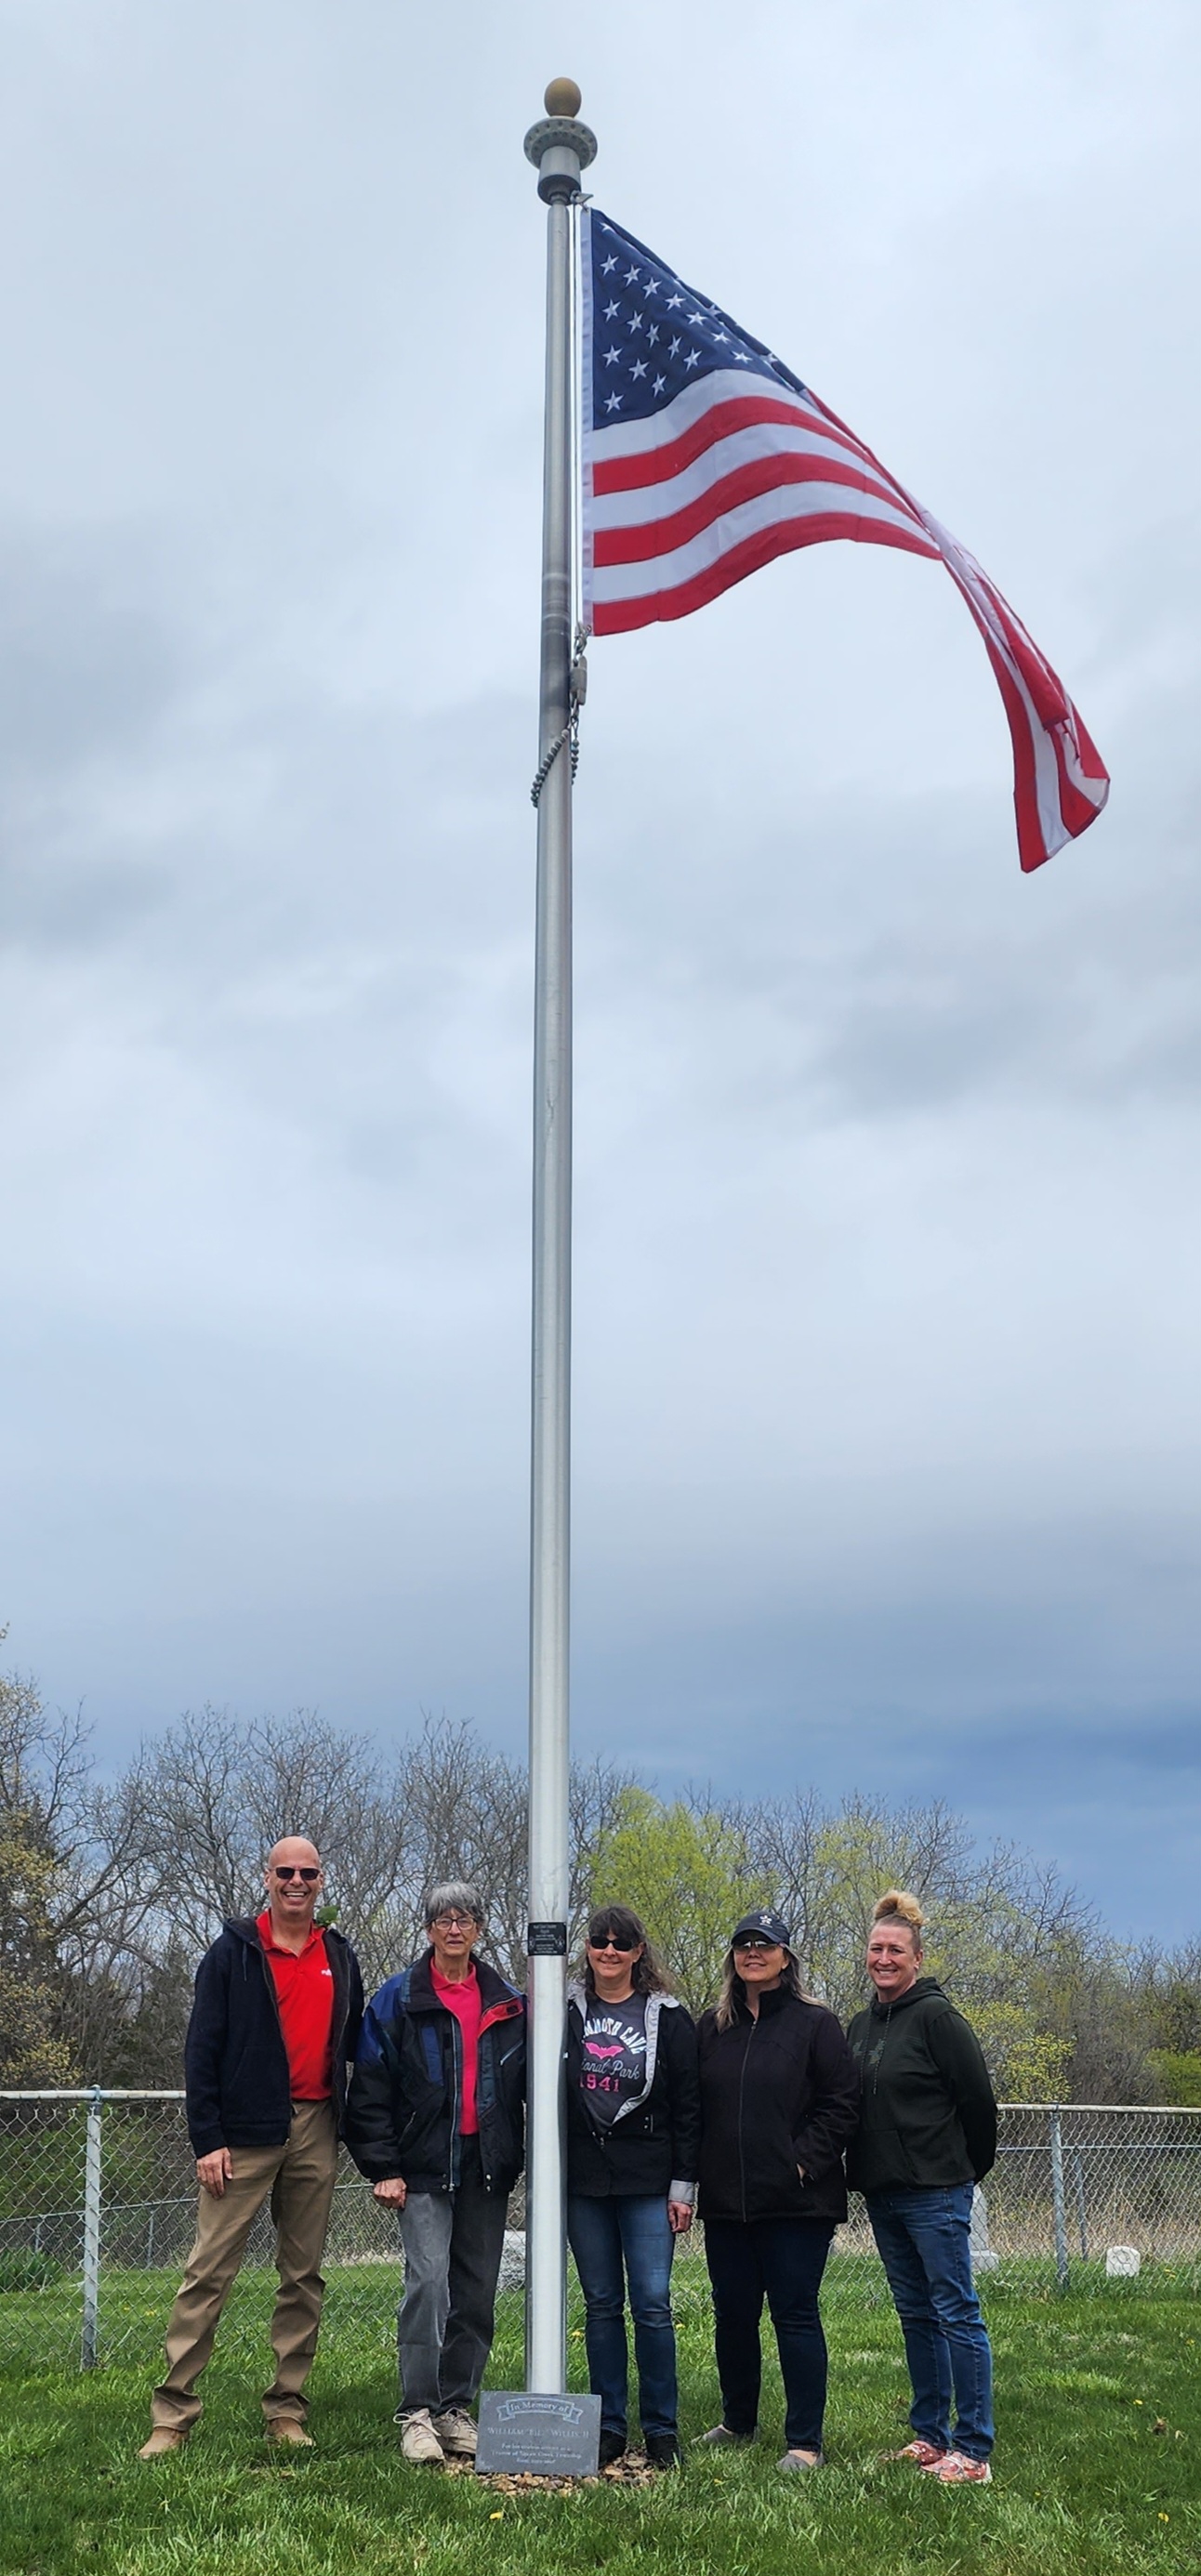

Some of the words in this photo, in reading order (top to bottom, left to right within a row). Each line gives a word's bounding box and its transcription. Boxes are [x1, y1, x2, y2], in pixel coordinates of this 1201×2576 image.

[610, 2059, 640, 2079] Park
[580, 2072, 619, 2092] 1941
[521, 2400, 559, 2412] Memory
